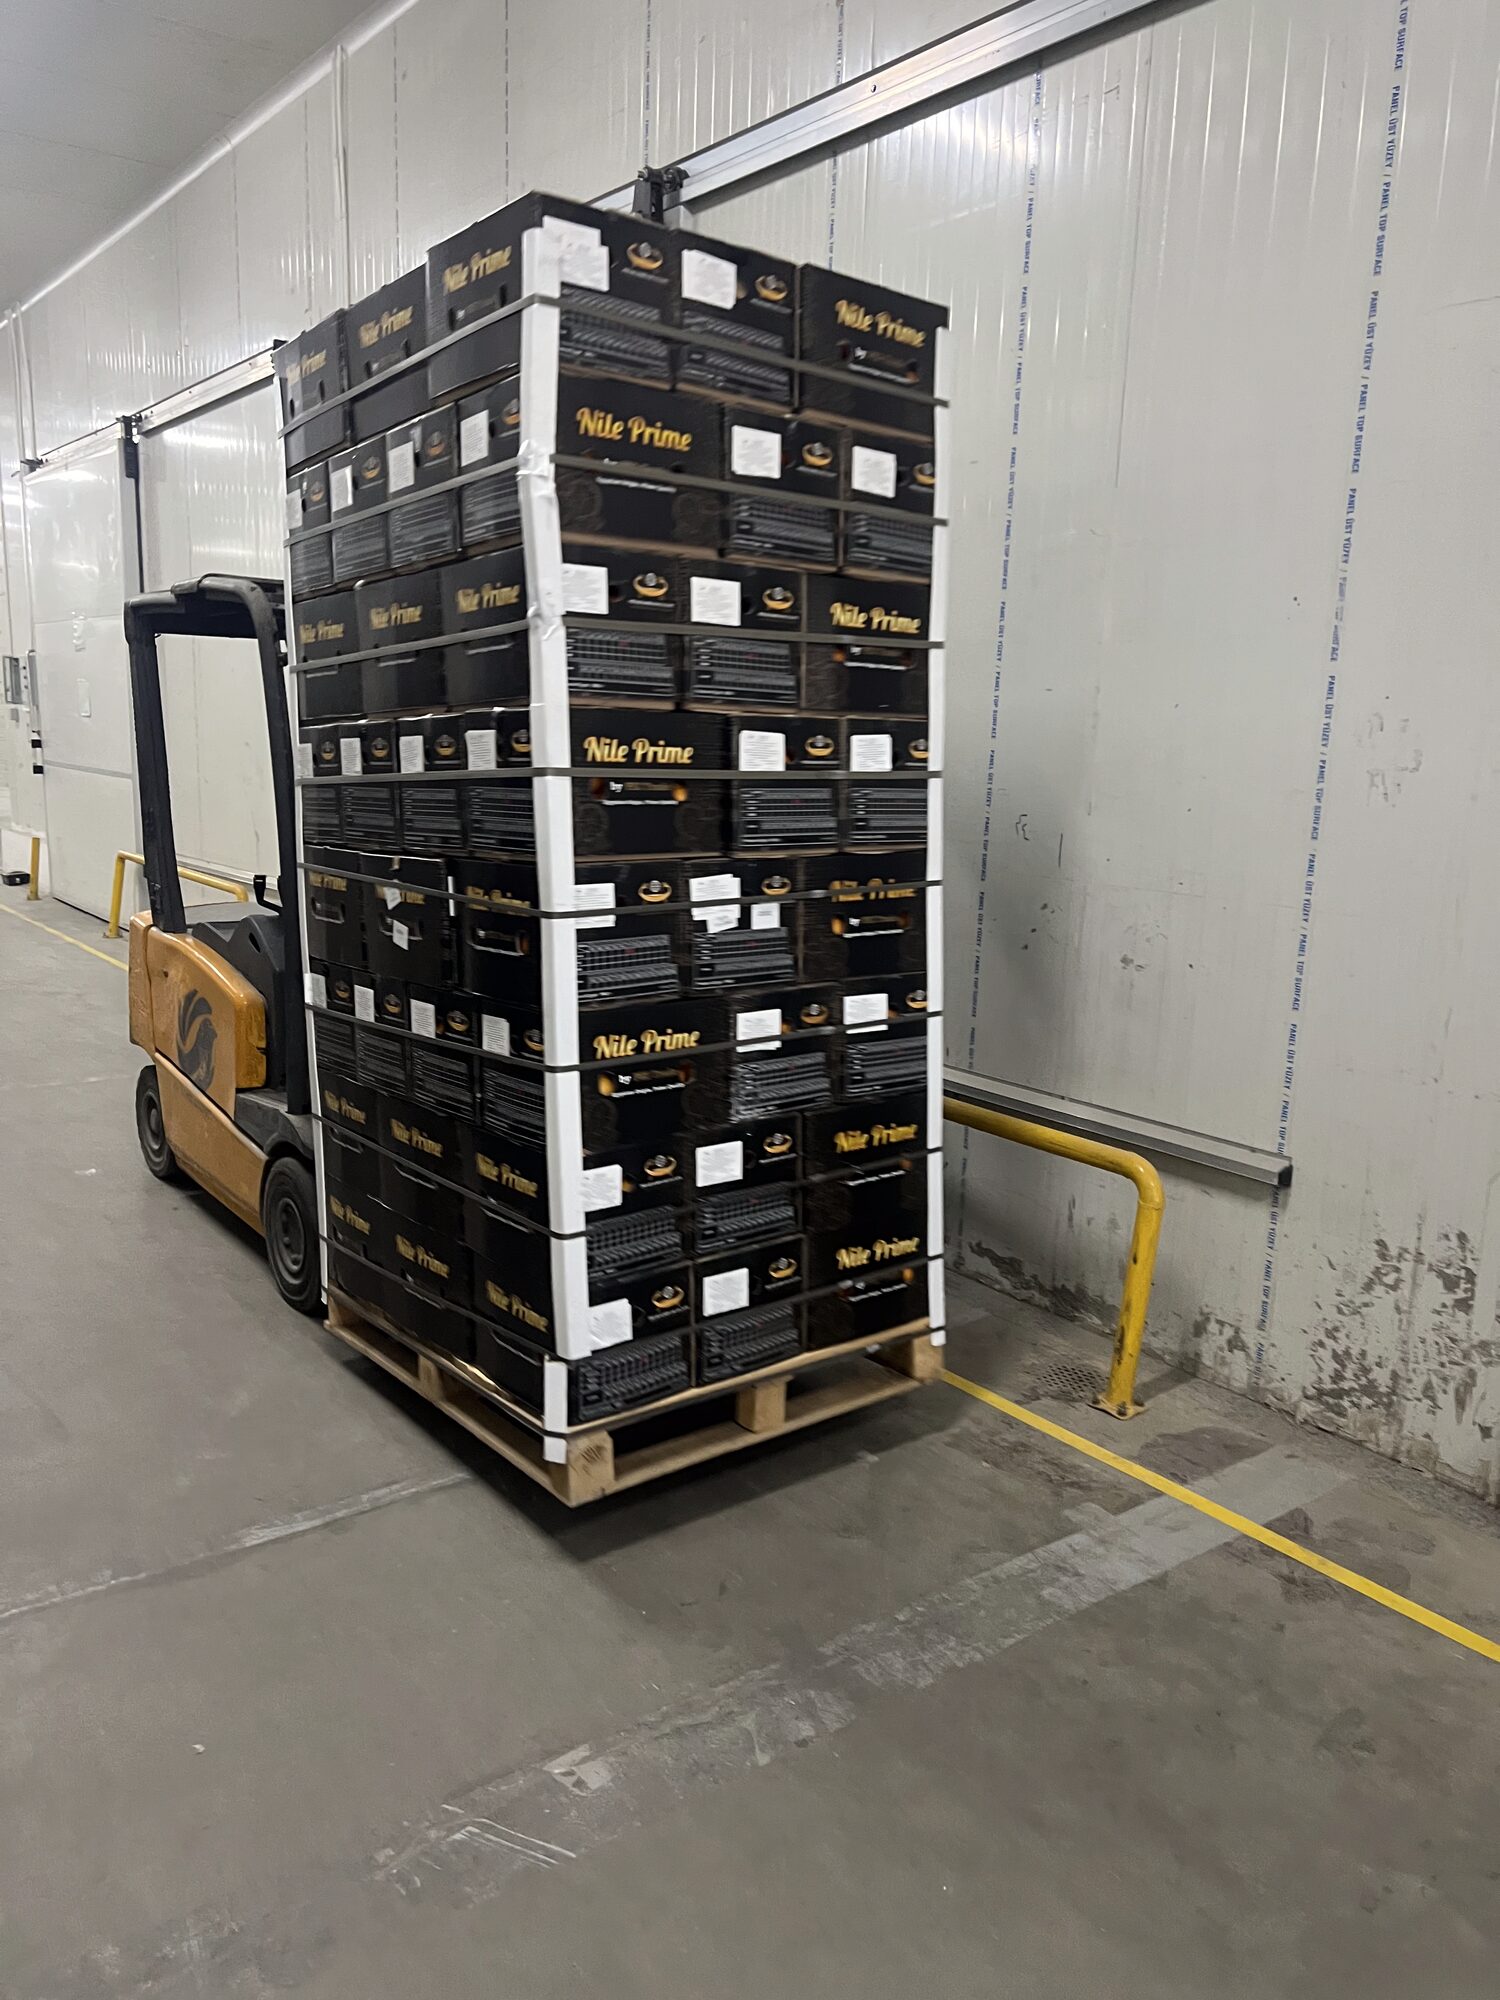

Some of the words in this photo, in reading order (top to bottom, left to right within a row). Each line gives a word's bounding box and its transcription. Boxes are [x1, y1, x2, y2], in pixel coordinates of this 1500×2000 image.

[836, 299, 873, 332] Nile
[876, 311, 927, 348] Prime
[576, 407, 624, 441] Nile
[628, 417, 692, 452] Prime
[830, 603, 867, 629] Nile
[870, 607, 922, 634] Prime
[584, 736, 627, 763] Nile
[632, 739, 694, 765] Prime
[593, 1034, 638, 1060] Nile
[641, 1029, 701, 1053] Prime
